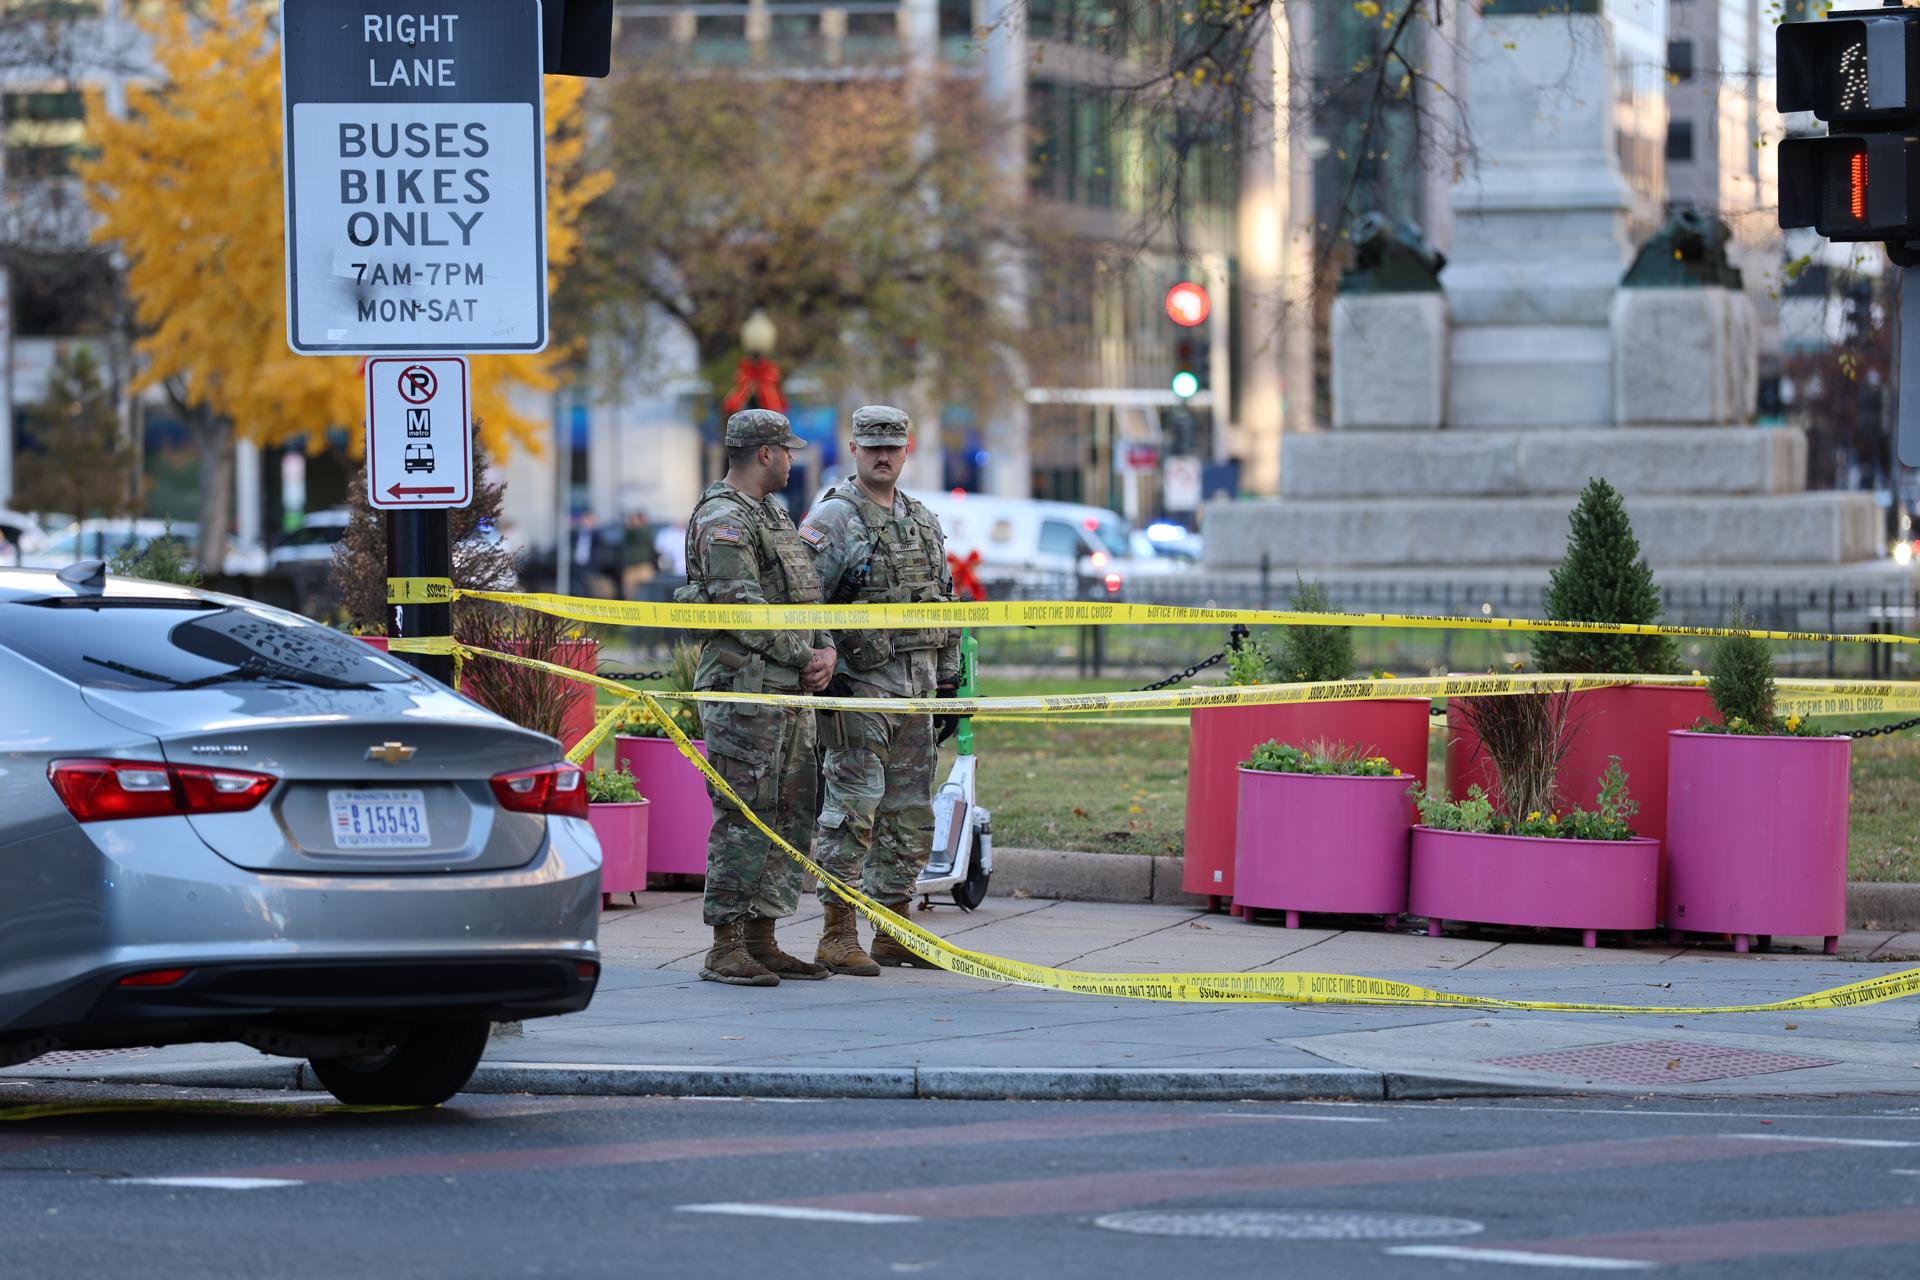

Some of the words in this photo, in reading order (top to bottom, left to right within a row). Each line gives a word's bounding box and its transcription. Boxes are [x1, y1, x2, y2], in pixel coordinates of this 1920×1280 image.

[364, 14, 459, 43] RIGHT
[369, 58, 456, 87] LANE
[339, 122, 490, 158] BUSES
[340, 168, 491, 205] BIKES
[346, 211, 485, 247] ONLY
[350, 263, 484, 286] 7AM-7PM
[357, 299, 478, 322] MON-SAT
[408, 410, 429, 431] M
[1324, 685, 1337, 699] NOT
[1335, 685, 1344, 698] DO
[1342, 684, 1359, 697] SCENE
[1357, 683, 1374, 696] CRIME
[1445, 682, 1461, 694] CROSS
[1462, 681, 1472, 693] NOT
[1480, 680, 1494, 692] SCENE
[1494, 679, 1510, 692] CRIME
[1308, 686, 1325, 700] CROSS
[366, 806, 420, 834] 15543
[909, 937, 929, 955] POLICE
[951, 956, 975, 975] CROSS
[976, 967, 991, 979] NOT
[1099, 984, 1112, 995] NOT
[1115, 984, 1126, 996] DO
[1129, 984, 1147, 997] LINE
[1147, 984, 1172, 998] POLICE
[1859, 986, 1877, 1002] NOT
[1876, 983, 1888, 998] DO
[1830, 990, 1858, 1007] CROSS
